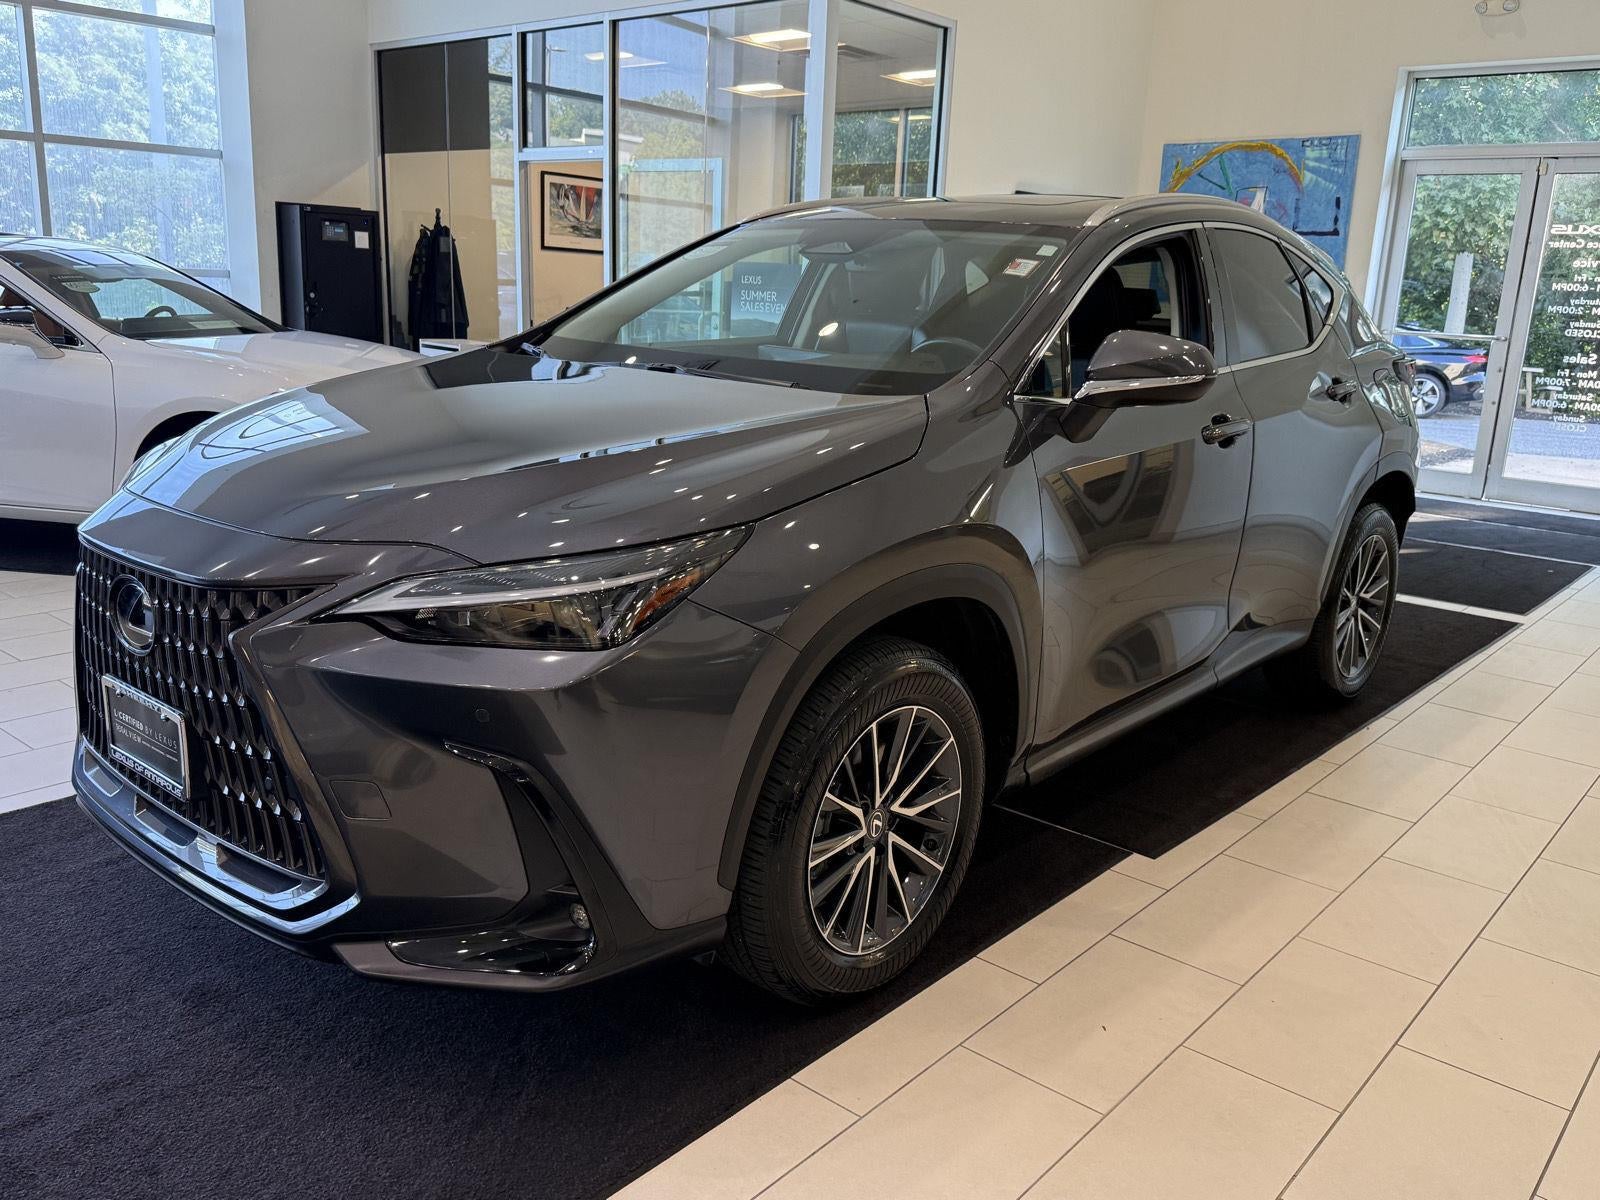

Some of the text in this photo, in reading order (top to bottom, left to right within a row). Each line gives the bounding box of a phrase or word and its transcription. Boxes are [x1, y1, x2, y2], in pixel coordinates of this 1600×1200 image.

[741, 275, 762, 285] LEXUS
[740, 289, 777, 302] SUMMER
[740, 301, 787, 314] SALES EVEN
[144, 725, 153, 736] BY
[154, 731, 178, 749] LEXUS
[111, 748, 135, 769] LEXUS
[134, 762, 144, 773] OF
[144, 768, 182, 797] ANNAPOLIS
